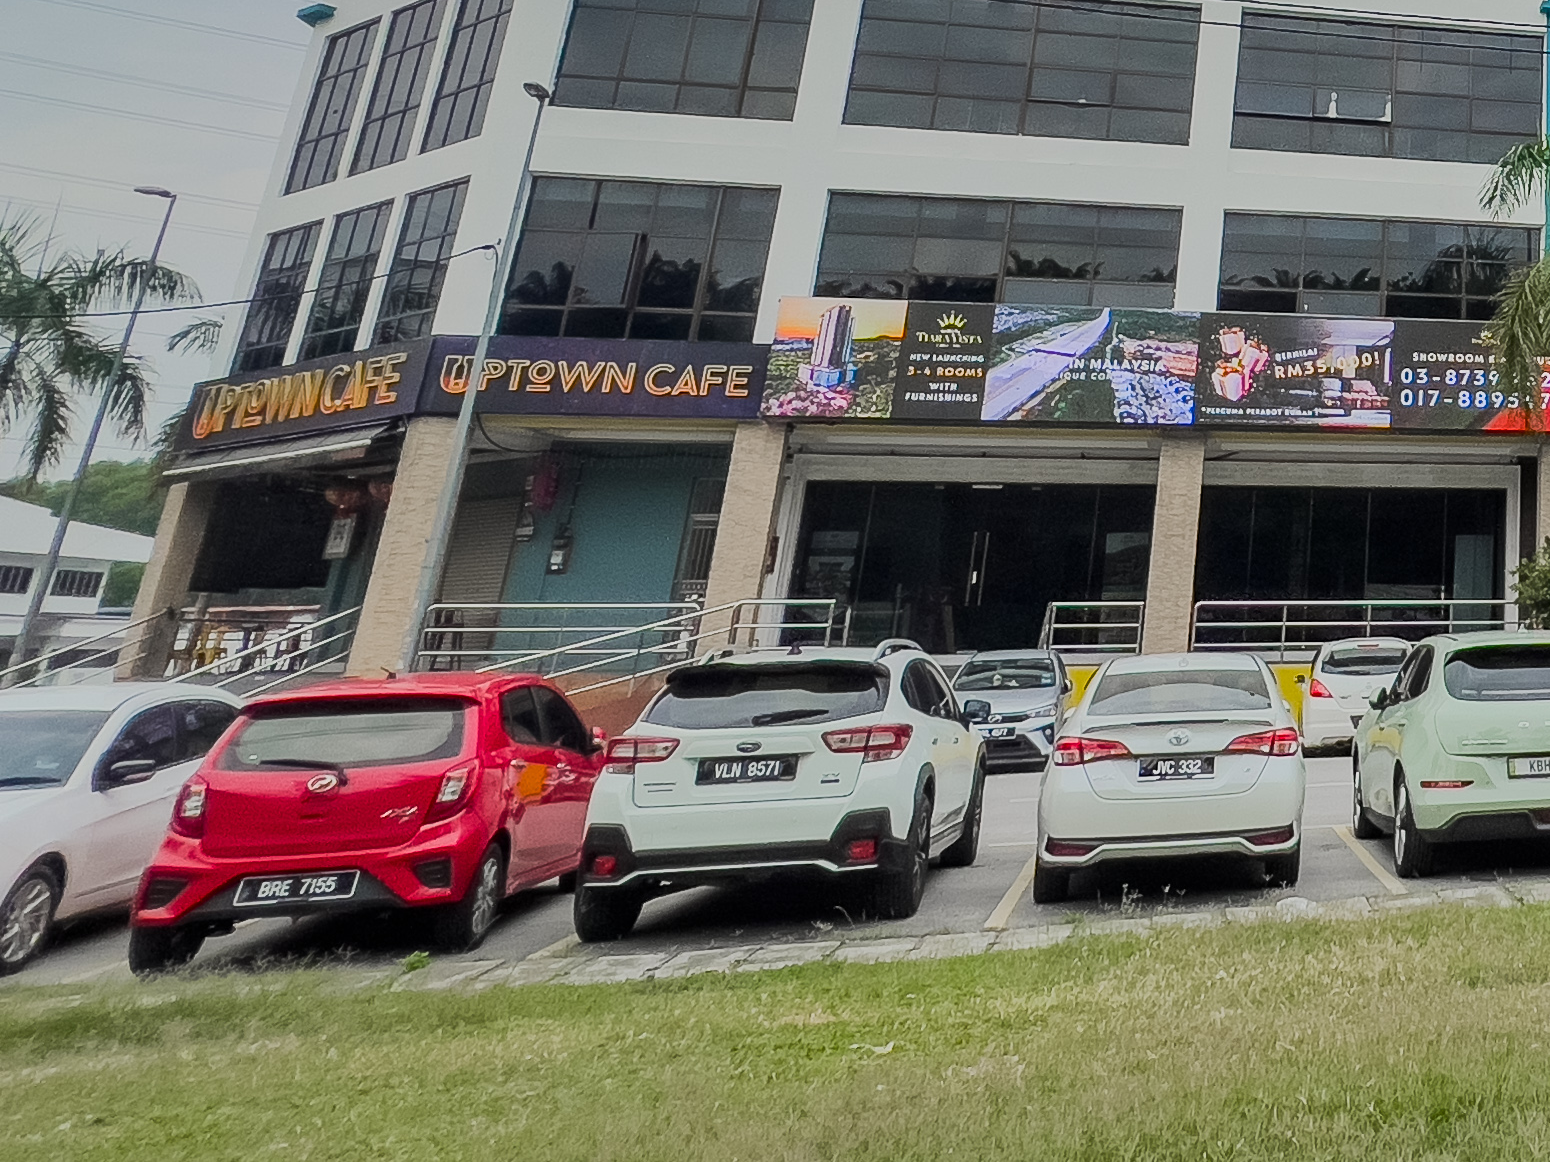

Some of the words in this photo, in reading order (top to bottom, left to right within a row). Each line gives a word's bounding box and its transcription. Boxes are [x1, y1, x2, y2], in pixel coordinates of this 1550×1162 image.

[1412, 351, 1485, 364] SHOWROOM
[936, 366, 983, 378] ROOMS
[1089, 358, 1167, 372] MALAYSIA
[439, 354, 637, 394] UPTOWN
[644, 363, 753, 397] CAFE
[928, 382, 958, 391] WITH
[192, 368, 325, 439] UPTOWN
[319, 352, 408, 415] CAFE
[904, 391, 979, 403] FURNISHINGS
[714, 761, 743, 779] VLN
[747, 760, 780, 777] 8571
[1152, 760, 1176, 775] JVC
[1178, 759, 1202, 774] 332
[1529, 759, 1550, 773] KBH
[257, 879, 294, 898] BRE
[299, 876, 338, 895] 7155
